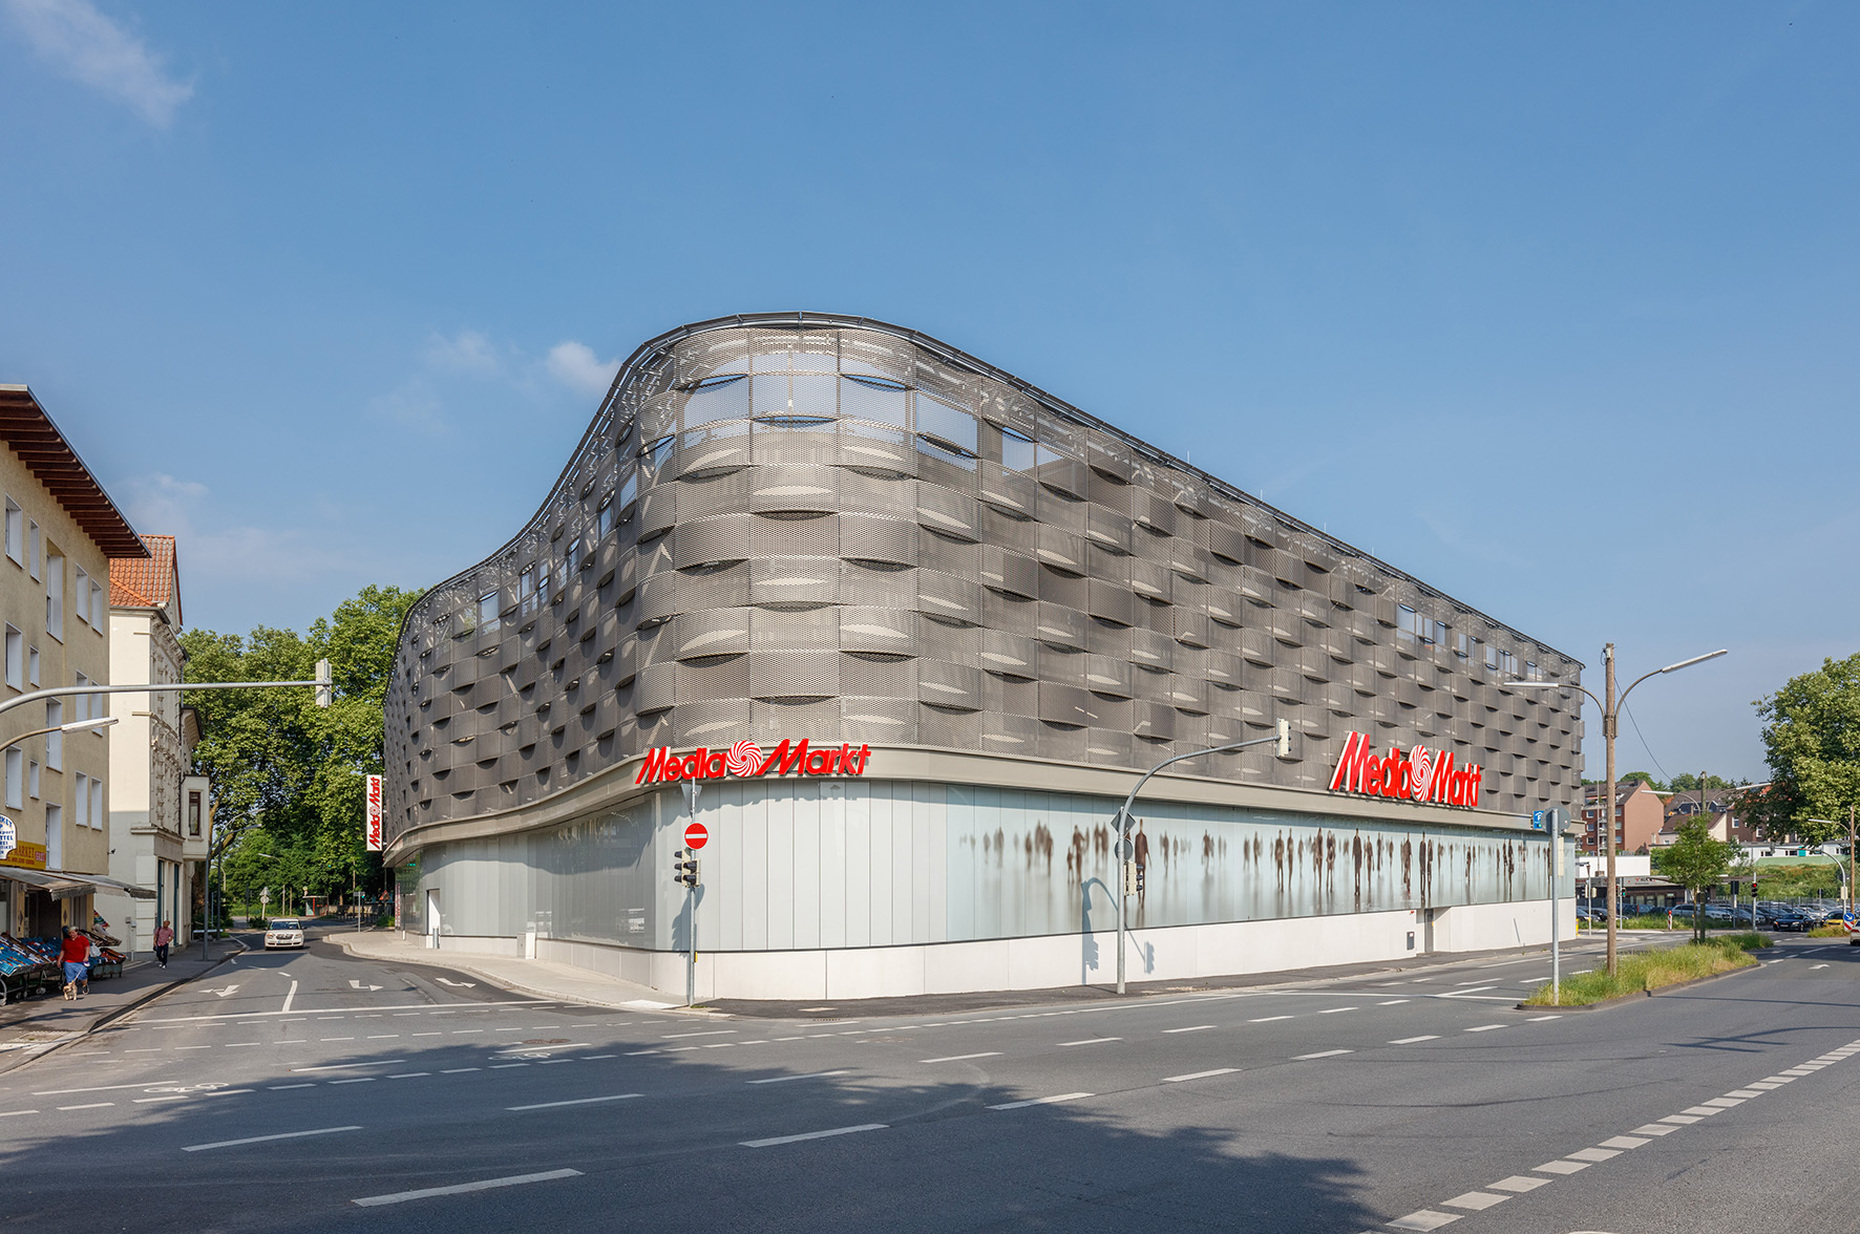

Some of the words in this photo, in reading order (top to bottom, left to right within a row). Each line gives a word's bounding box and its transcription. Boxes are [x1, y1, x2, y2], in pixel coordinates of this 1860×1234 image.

[635, 746, 727, 784] Media
[755, 738, 871, 776] Markt
[1329, 731, 1412, 799] Media
[1428, 750, 1482, 807] Markt
[368, 777, 381, 808] Markt
[368, 815, 381, 849] Media
